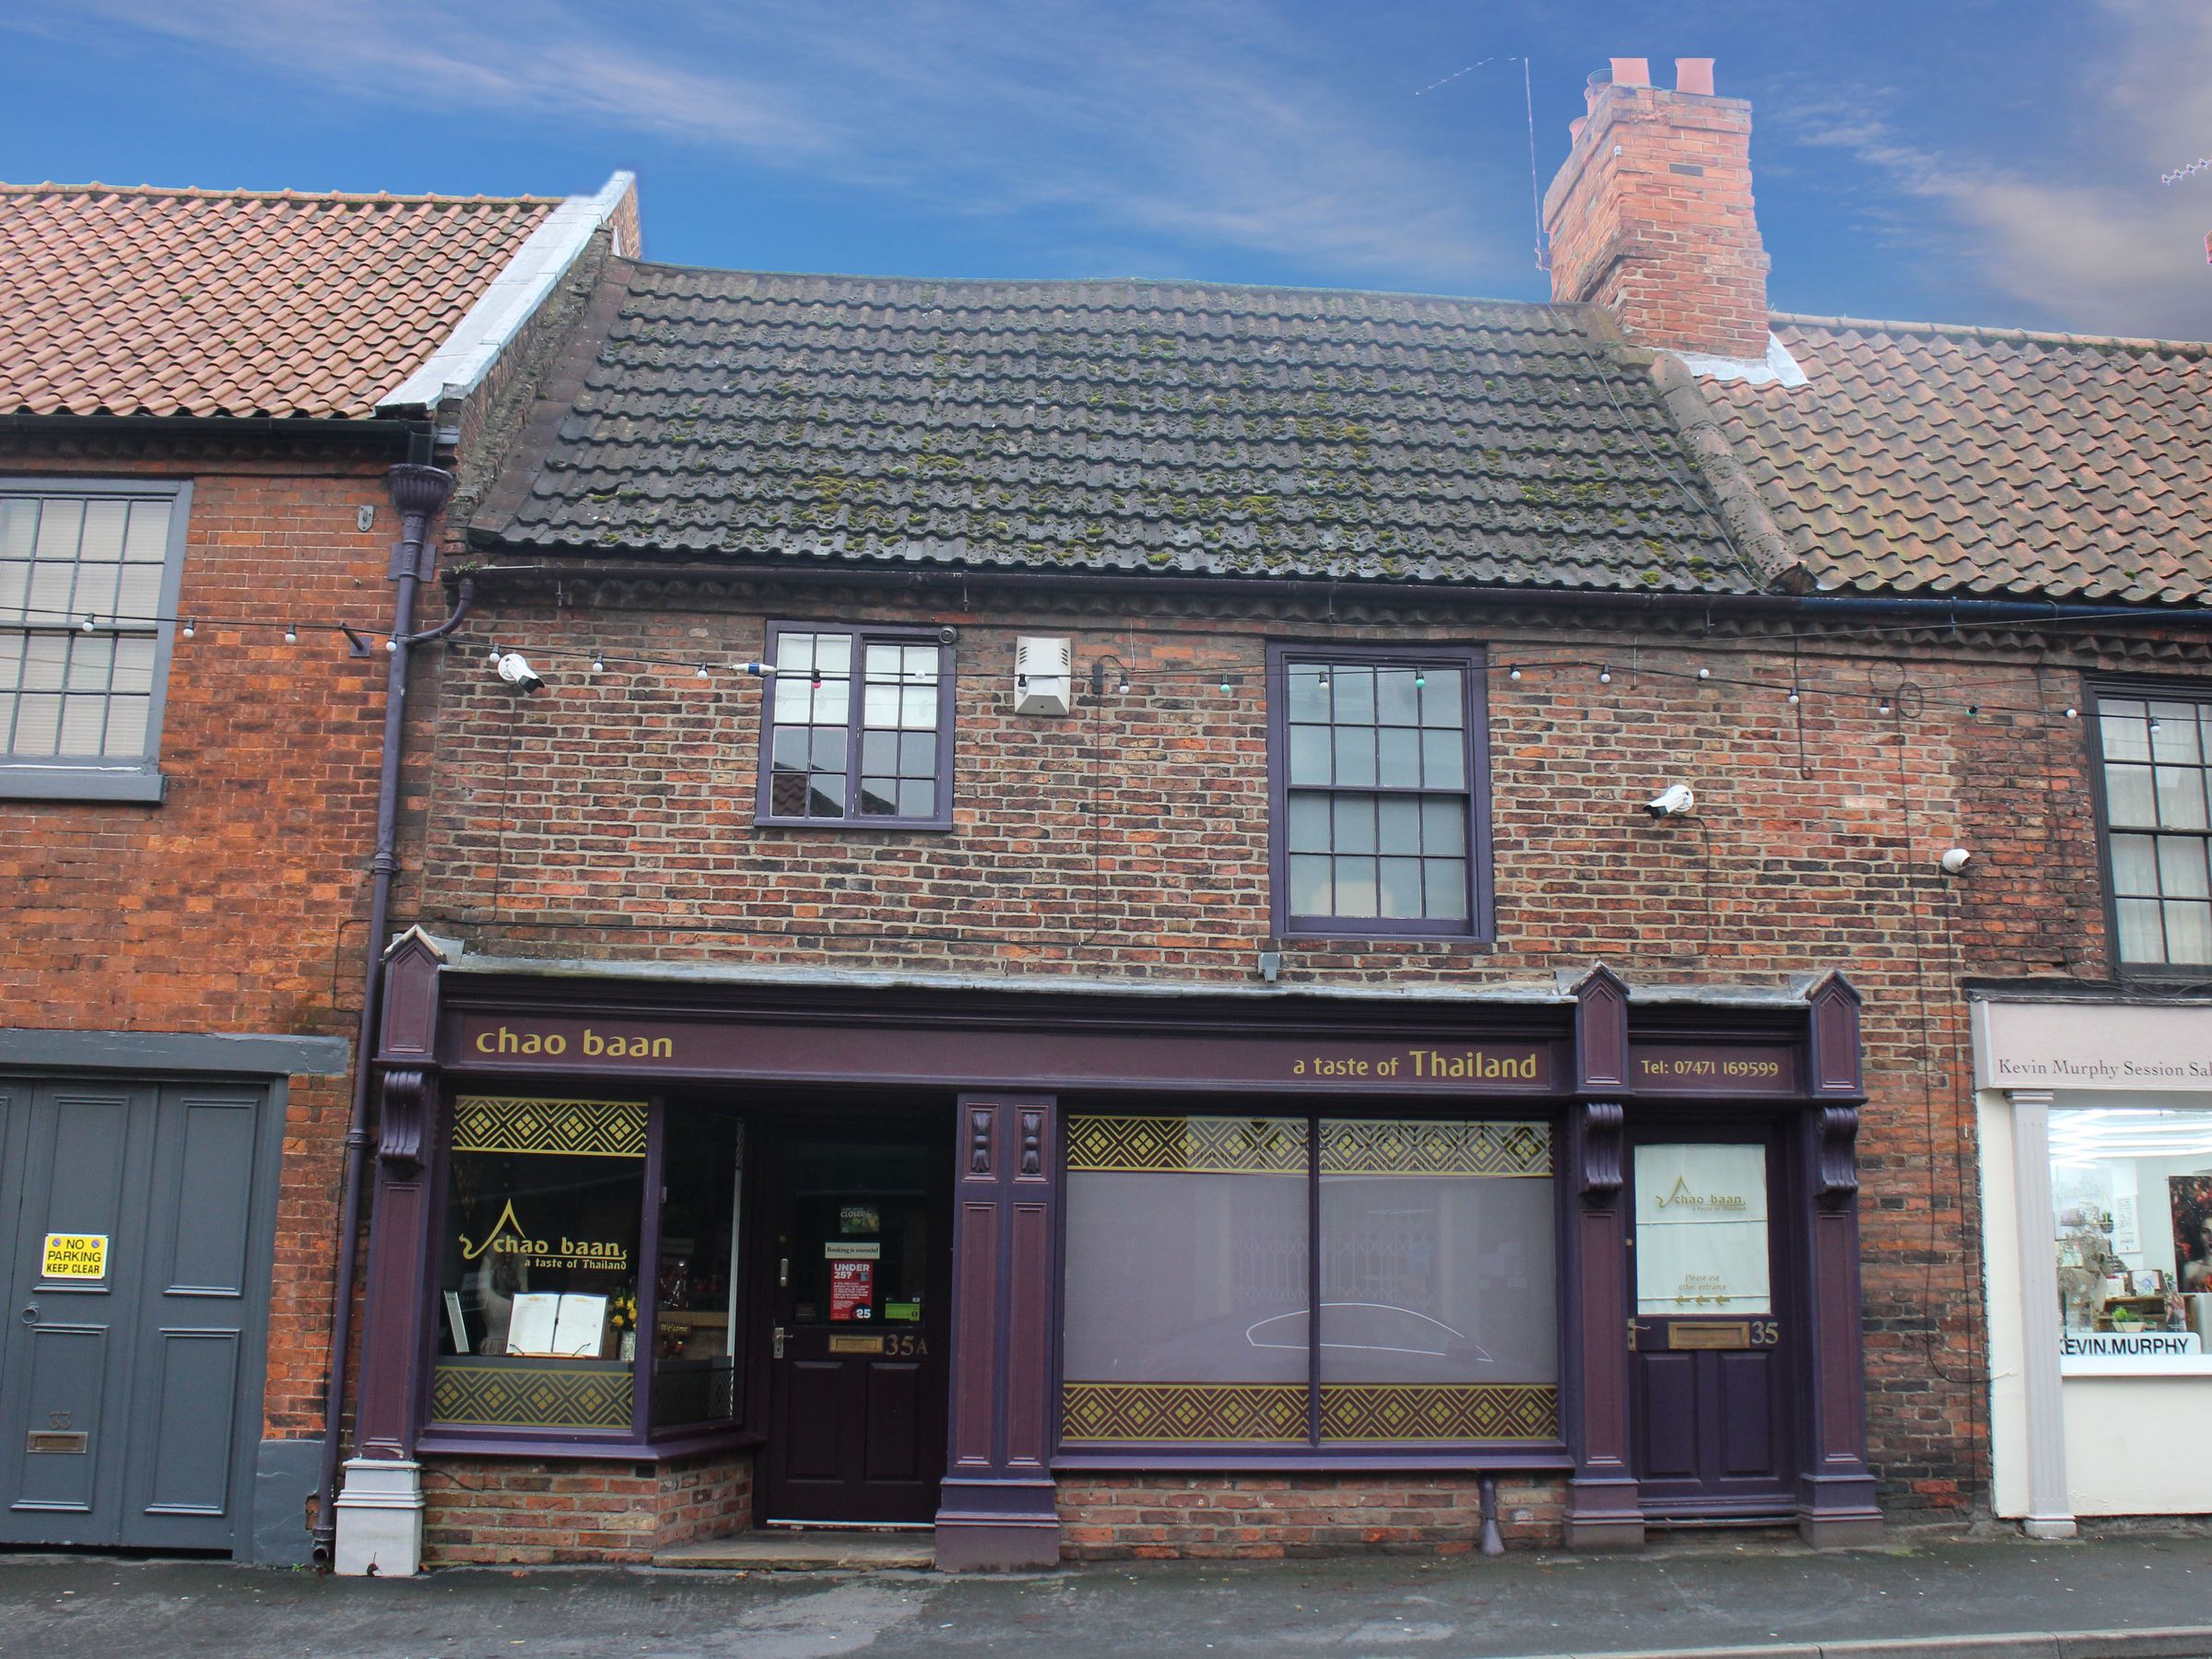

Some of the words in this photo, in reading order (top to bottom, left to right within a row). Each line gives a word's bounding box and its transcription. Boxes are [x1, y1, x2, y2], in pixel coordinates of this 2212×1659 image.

[476, 1026, 567, 1055] chao
[582, 1028, 673, 1058] baan
[1293, 1060, 1306, 1075] a
[1313, 1057, 1369, 1076] taste
[1377, 1057, 1399, 1077] of
[1409, 1050, 1536, 1078] Thailand
[1641, 1060, 1669, 1075] Tel:
[1674, 1061, 1715, 1076] 07471
[1723, 1062, 1779, 1077] 169599
[1998, 1059, 2048, 1076] Kevin
[2053, 1060, 2119, 1080] Murphy
[2124, 1060, 2183, 1077] Session
[1675, 1194, 1704, 1204] chao
[1711, 1194, 1742, 1204] baan
[65, 1239, 85, 1250] NO
[494, 1235, 548, 1253] chao
[561, 1236, 619, 1256] baan
[47, 1251, 101, 1262] PARKING
[535, 1258, 562, 1268] taste
[567, 1259, 578, 1268] of
[582, 1259, 627, 1270] Thailand
[46, 1264, 69, 1273] KEEP
[71, 1264, 100, 1274] CLEAR
[834, 1264, 870, 1272] UNDER
[856, 1309, 871, 1319] 25
[1751, 1321, 1779, 1344] 35
[886, 1334, 928, 1356] 35A
[50, 1411, 72, 1430] 33
